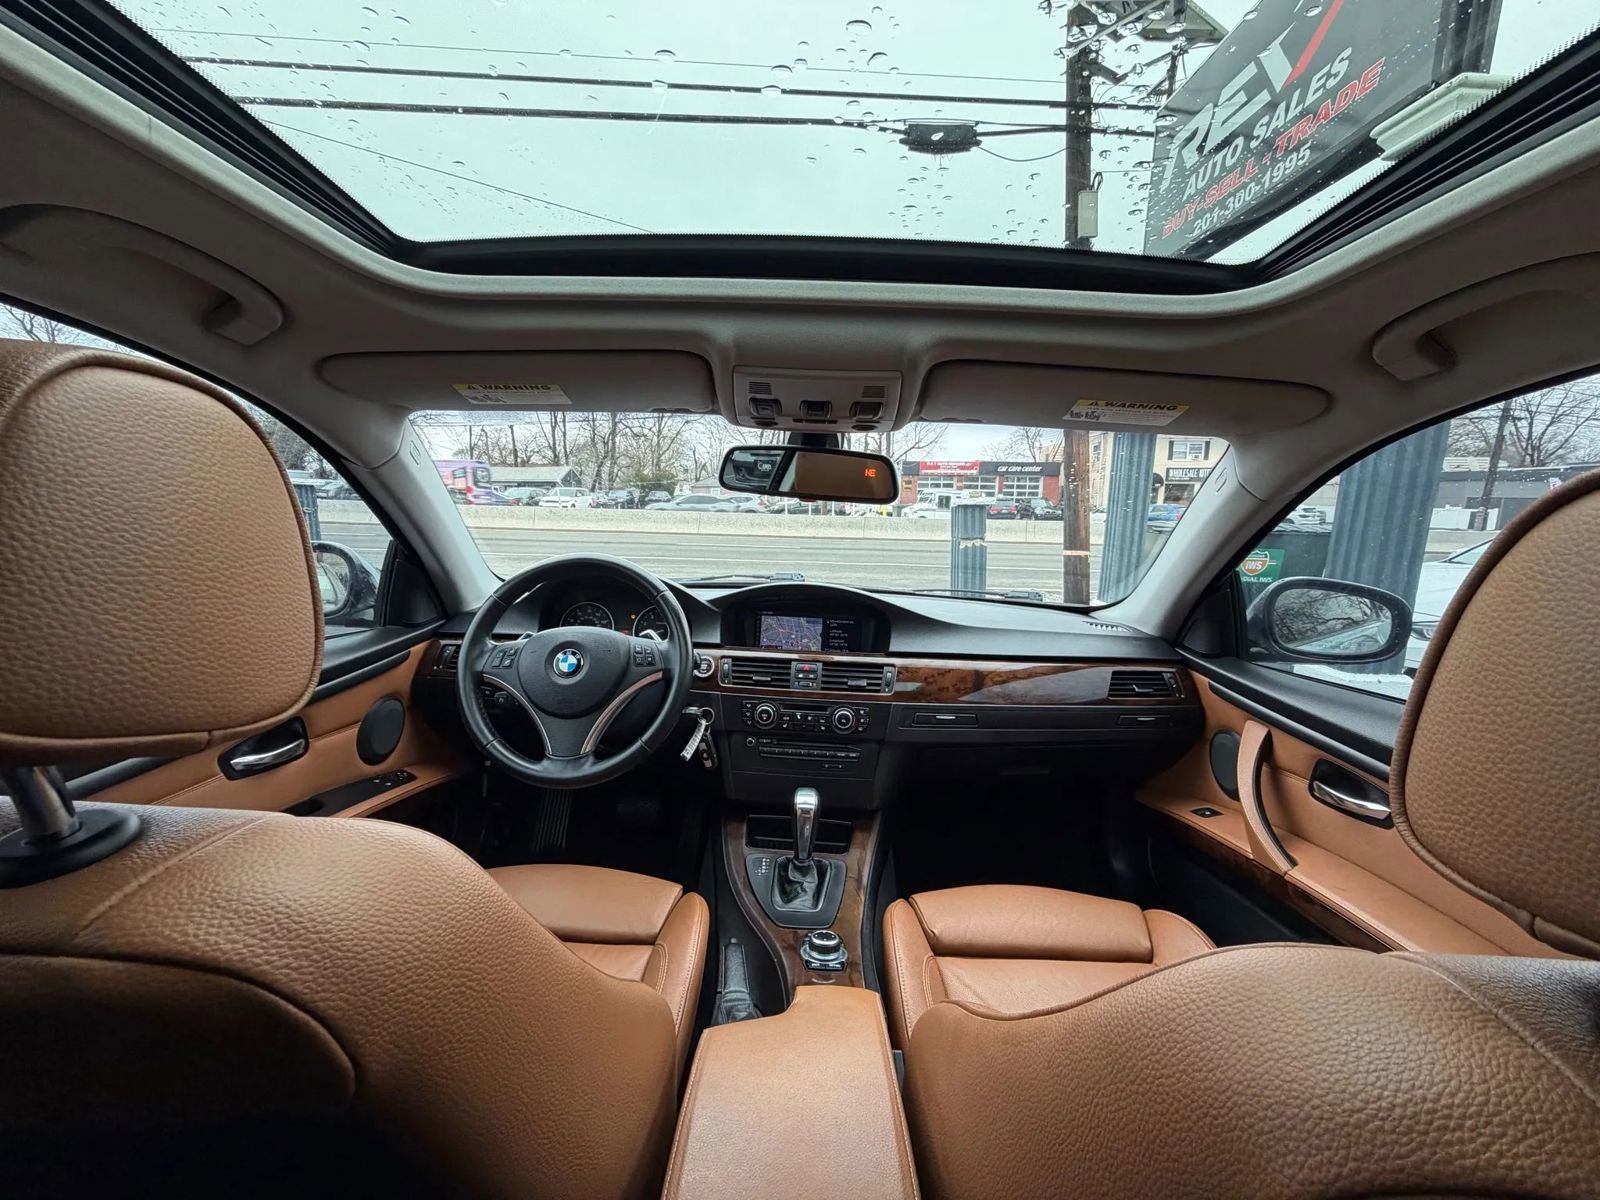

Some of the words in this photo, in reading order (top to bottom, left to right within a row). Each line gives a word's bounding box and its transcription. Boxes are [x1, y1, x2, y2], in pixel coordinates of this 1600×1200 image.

[1182, 135, 1244, 203] AUTO
[1250, 47, 1352, 149] SALES
[1273, 56, 1386, 158] TRADE
[1191, 139, 1312, 237] 201-300-1995
[1105, 401, 1178, 411] WARNING
[1245, 561, 1262, 570] IWS
